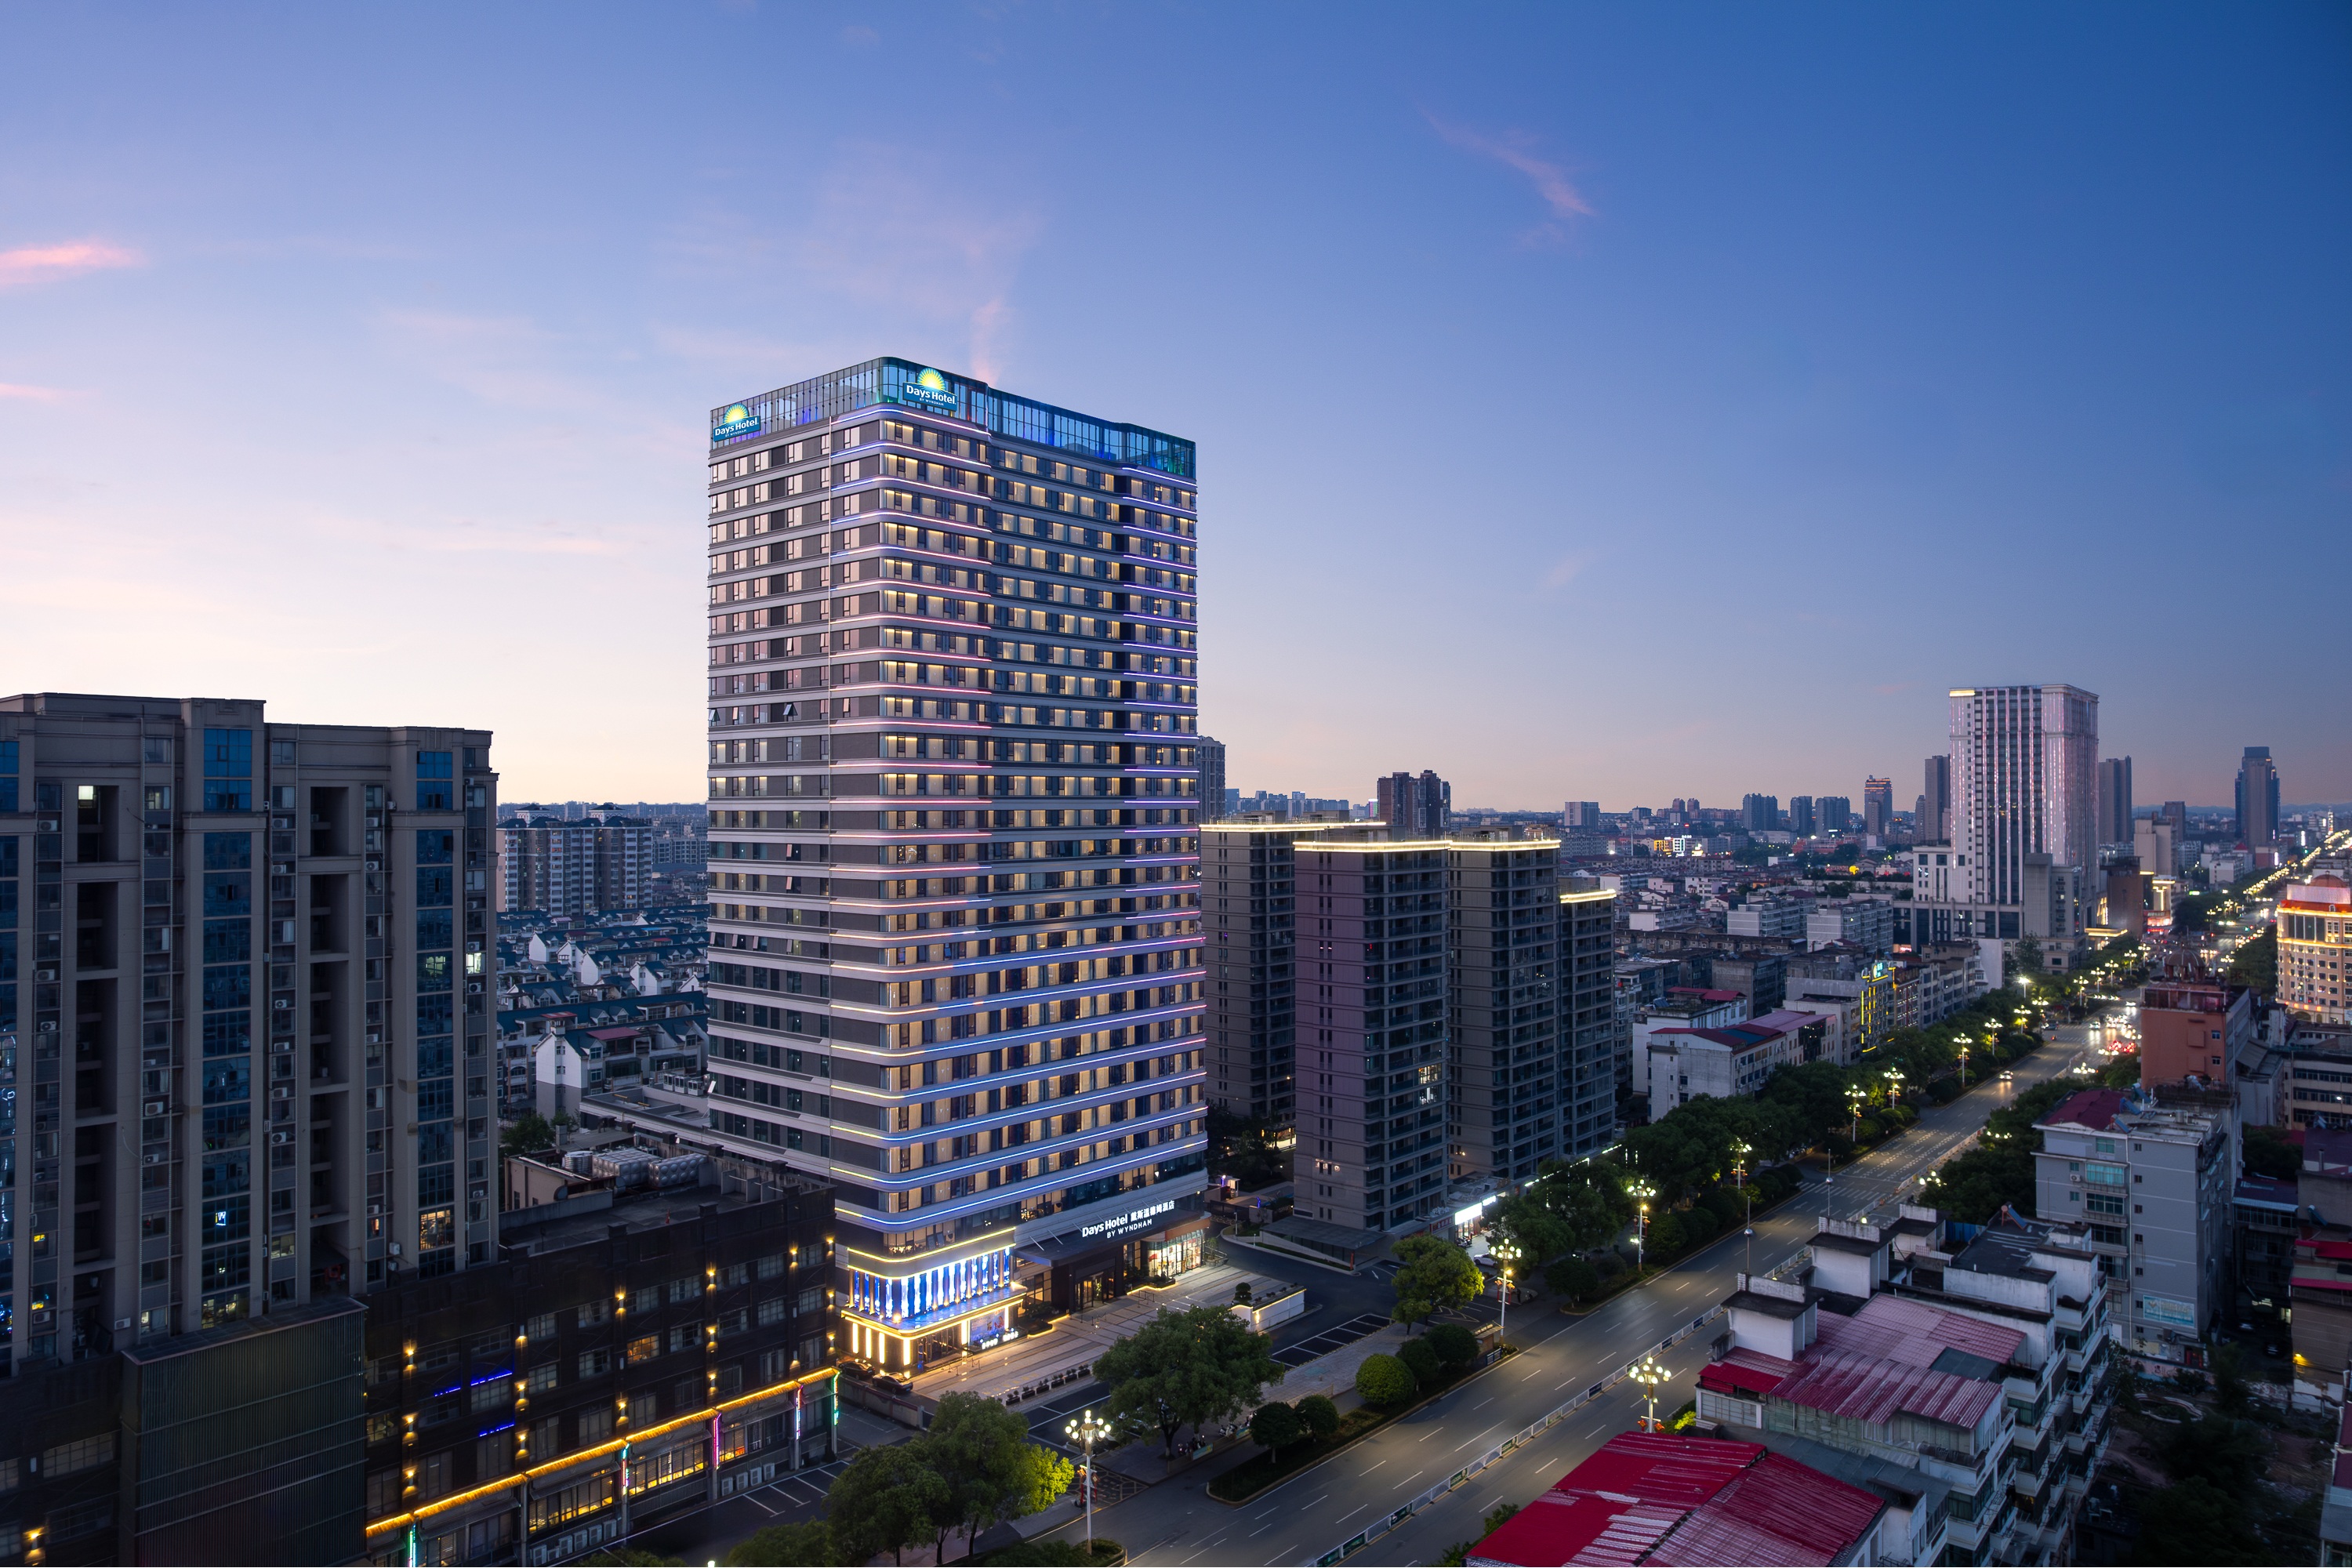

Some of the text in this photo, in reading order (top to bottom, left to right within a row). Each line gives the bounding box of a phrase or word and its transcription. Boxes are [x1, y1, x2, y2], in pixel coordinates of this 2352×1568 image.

[906, 385, 955, 405] Days Hotel
[715, 417, 757, 436] Days Hotel
[1082, 1214, 1128, 1237] Days Hotel
[1107, 1218, 1152, 1239] BY WYNDHAM
